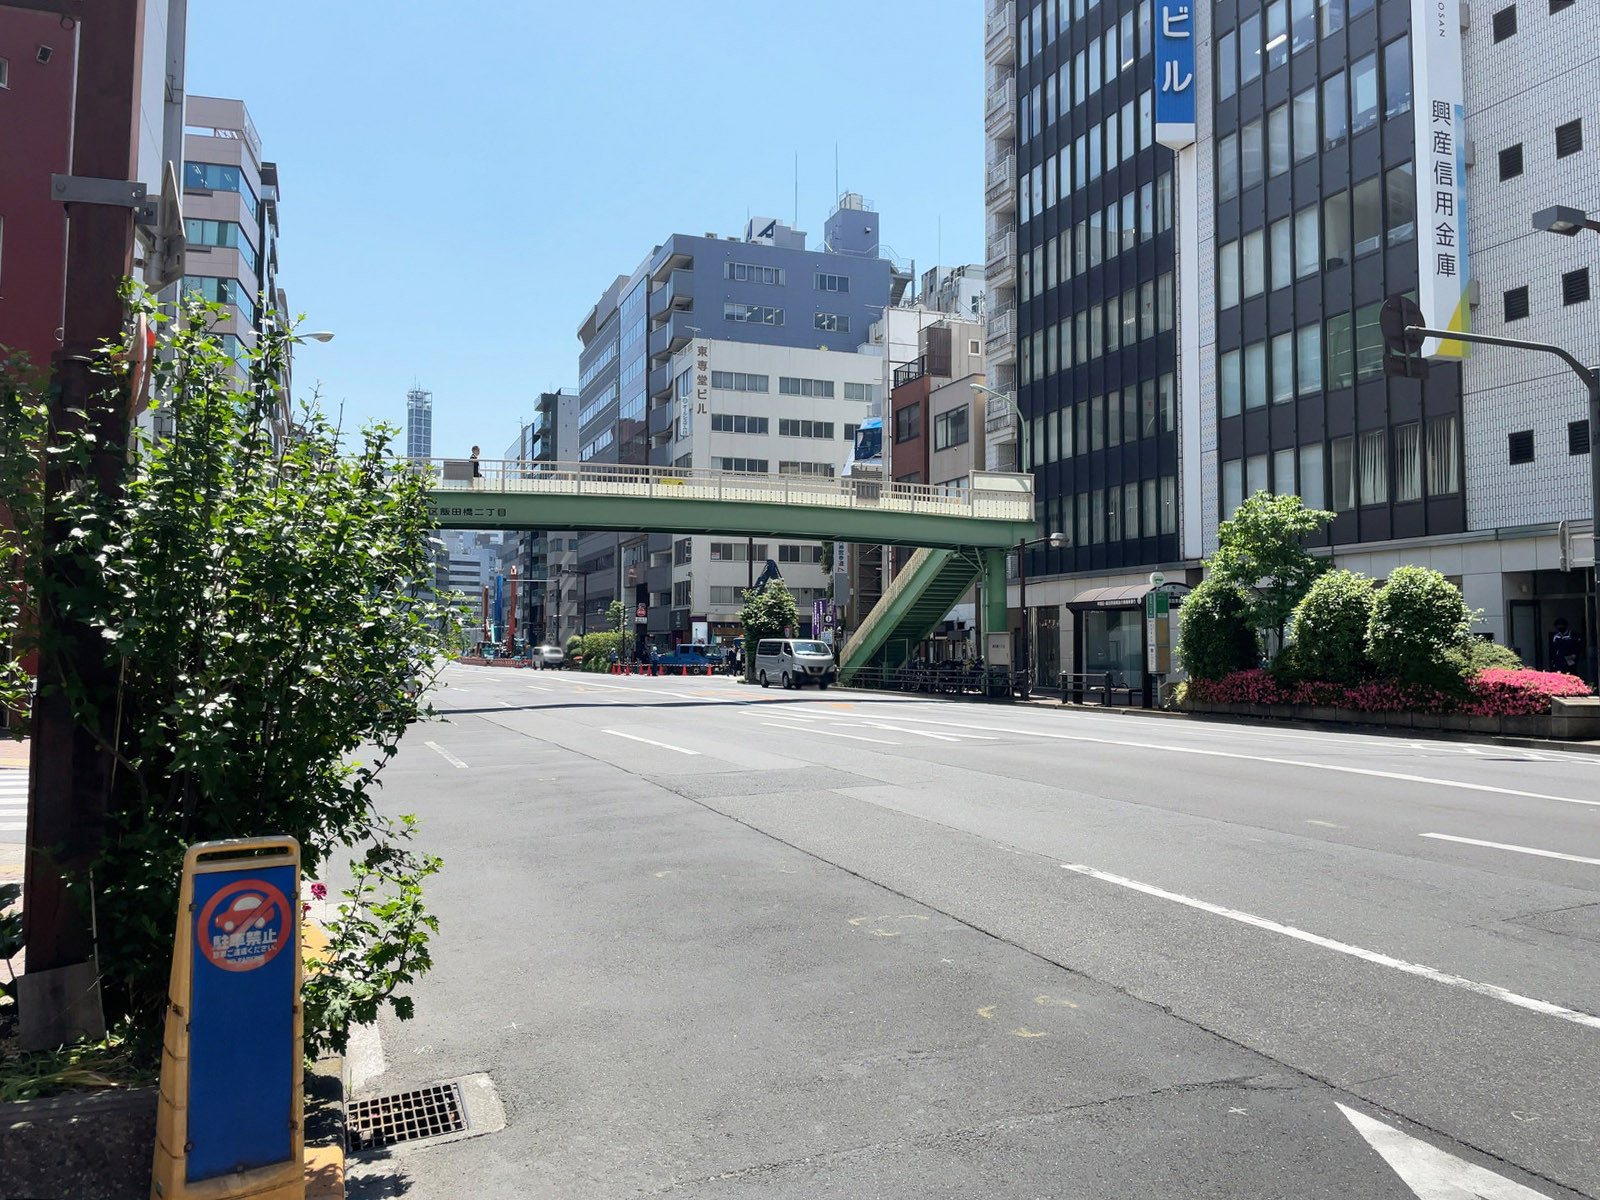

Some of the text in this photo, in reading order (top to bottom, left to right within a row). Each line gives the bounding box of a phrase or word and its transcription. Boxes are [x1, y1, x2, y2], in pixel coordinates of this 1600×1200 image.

[1162, 5, 1193, 93] ビル
[1431, 99, 1456, 278] 興産信用金庫
[696, 345, 709, 415] 東専堂ビル
[213, 928, 278, 950] 駐車禁止
